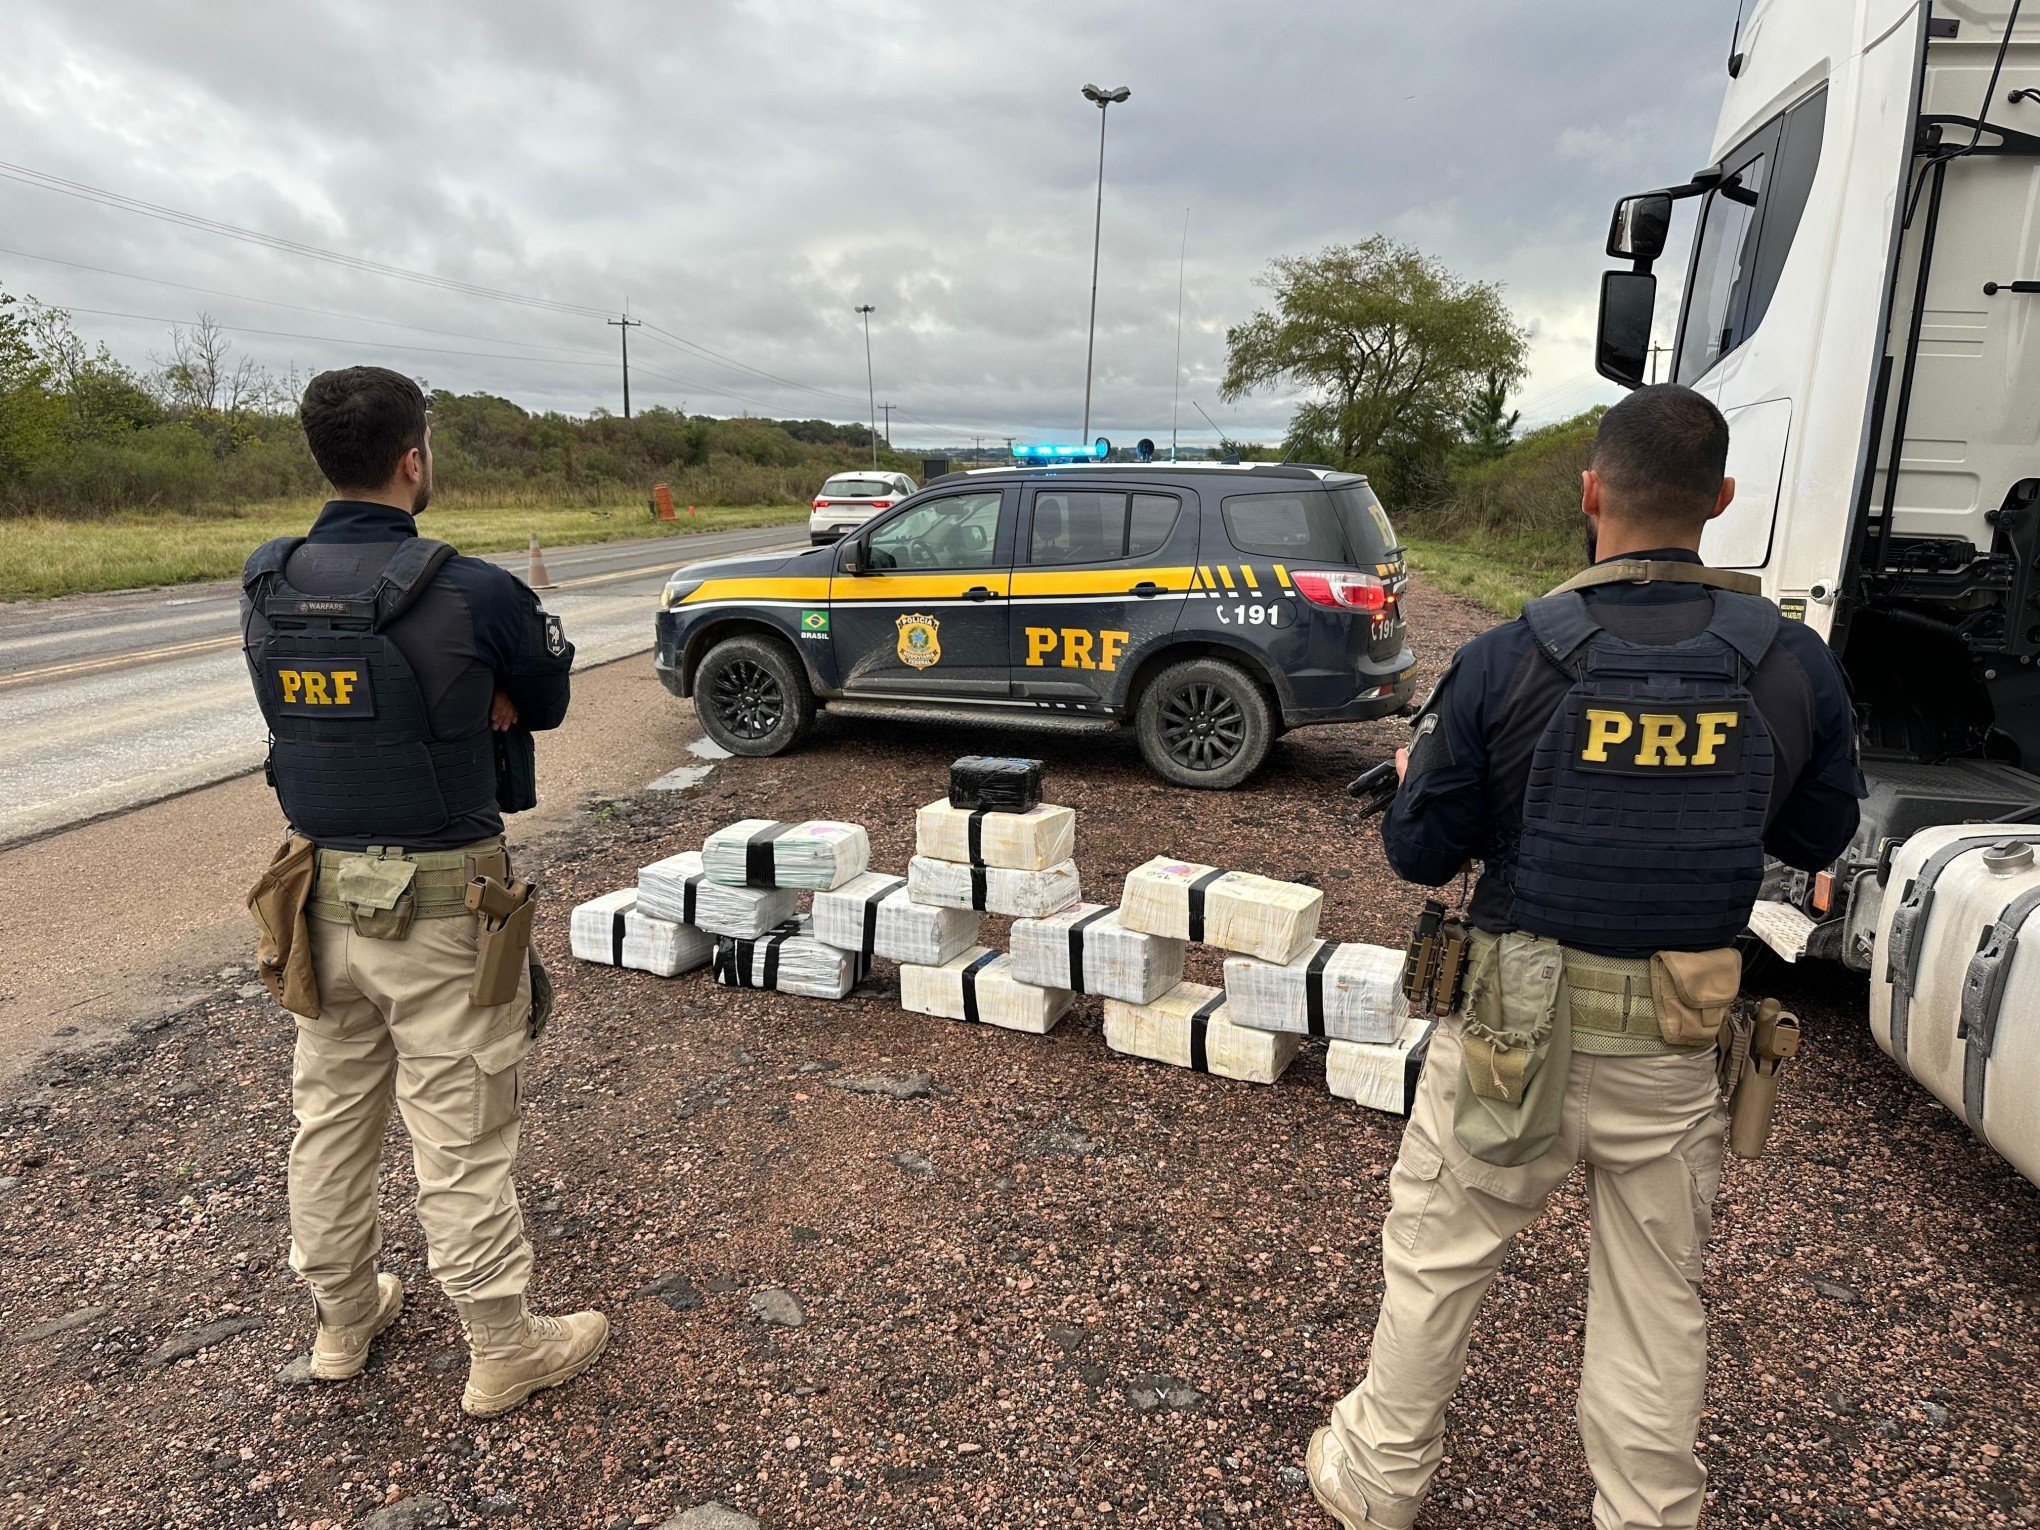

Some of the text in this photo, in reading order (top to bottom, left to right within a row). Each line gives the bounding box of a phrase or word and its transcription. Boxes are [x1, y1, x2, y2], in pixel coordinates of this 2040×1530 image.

[309, 602, 344, 610] WARFARE
[1234, 604, 1279, 626] 191
[801, 632, 829, 640] BRASIL
[1379, 618, 1394, 640] 191
[1025, 627, 1129, 671] PRF
[278, 670, 358, 705] PRF
[1581, 709, 1739, 767] PRF
